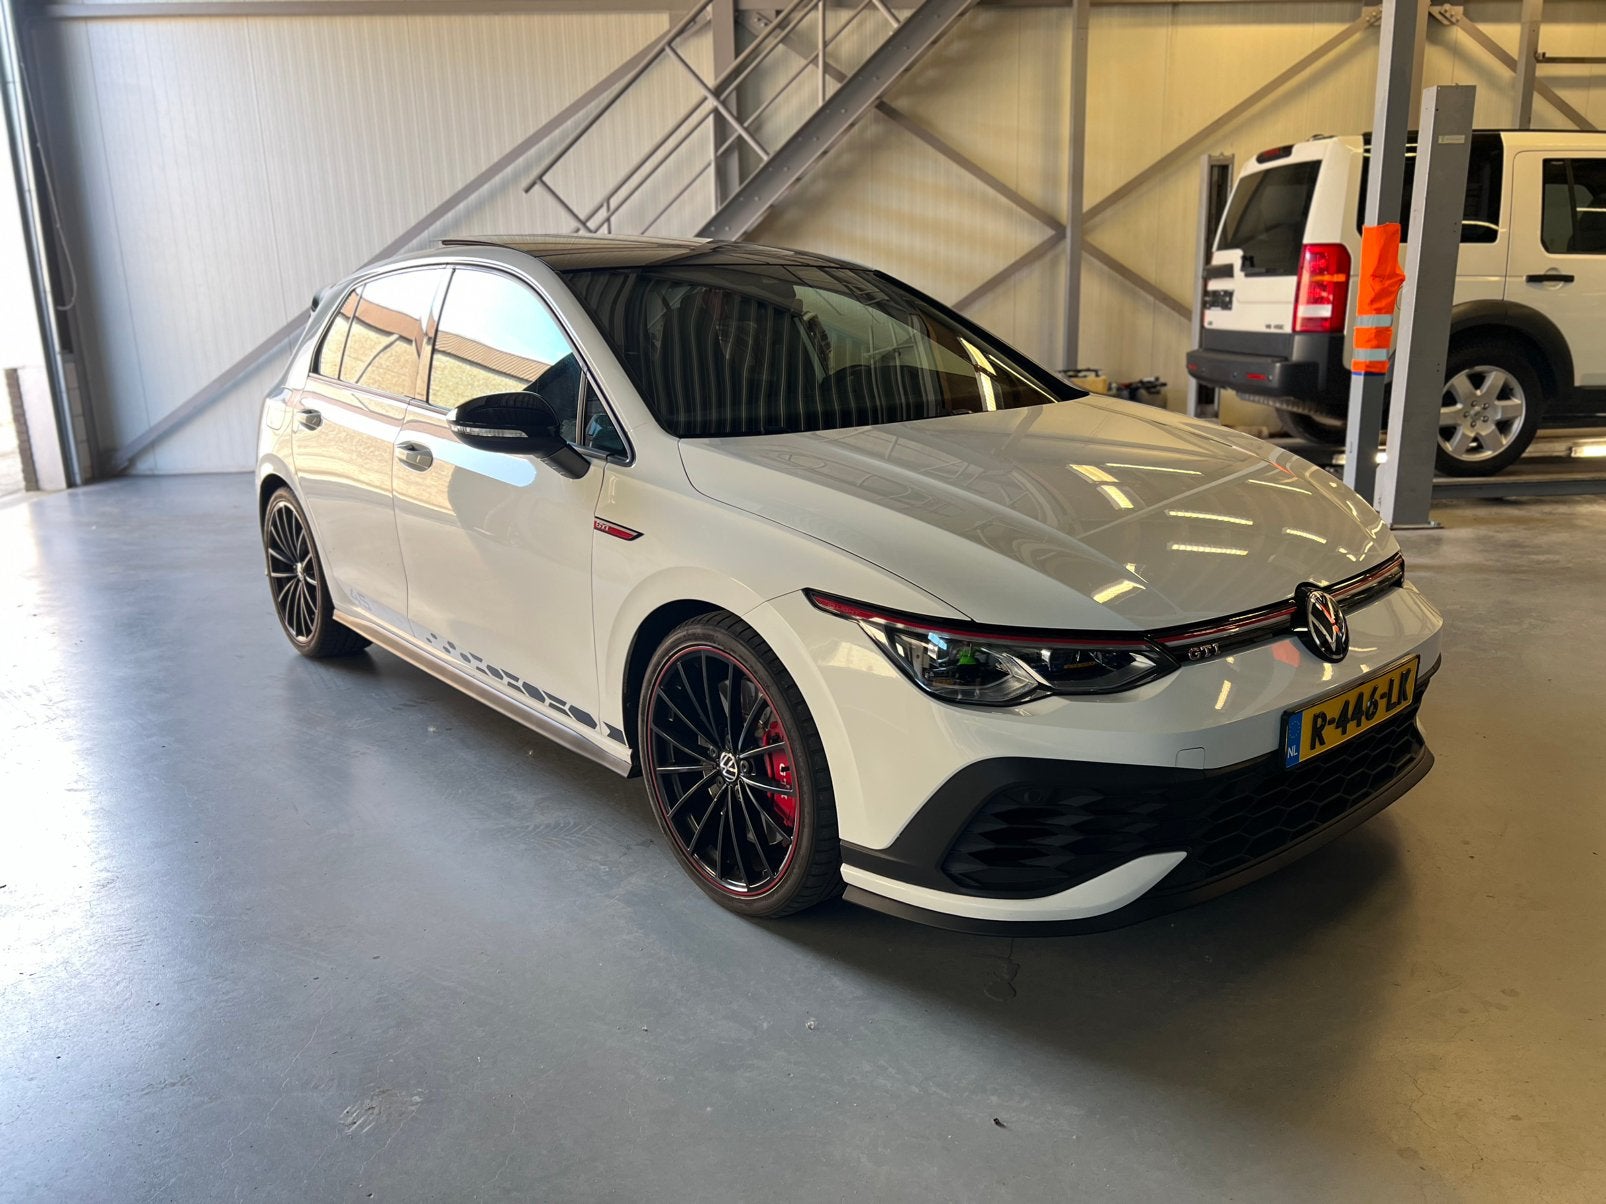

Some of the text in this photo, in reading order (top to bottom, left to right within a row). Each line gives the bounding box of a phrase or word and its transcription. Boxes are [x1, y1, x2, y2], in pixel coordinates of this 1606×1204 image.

[1188, 643, 1220, 660] GTI
[1310, 668, 1411, 750] R-446-LK
[1287, 745, 1298, 758] NL
